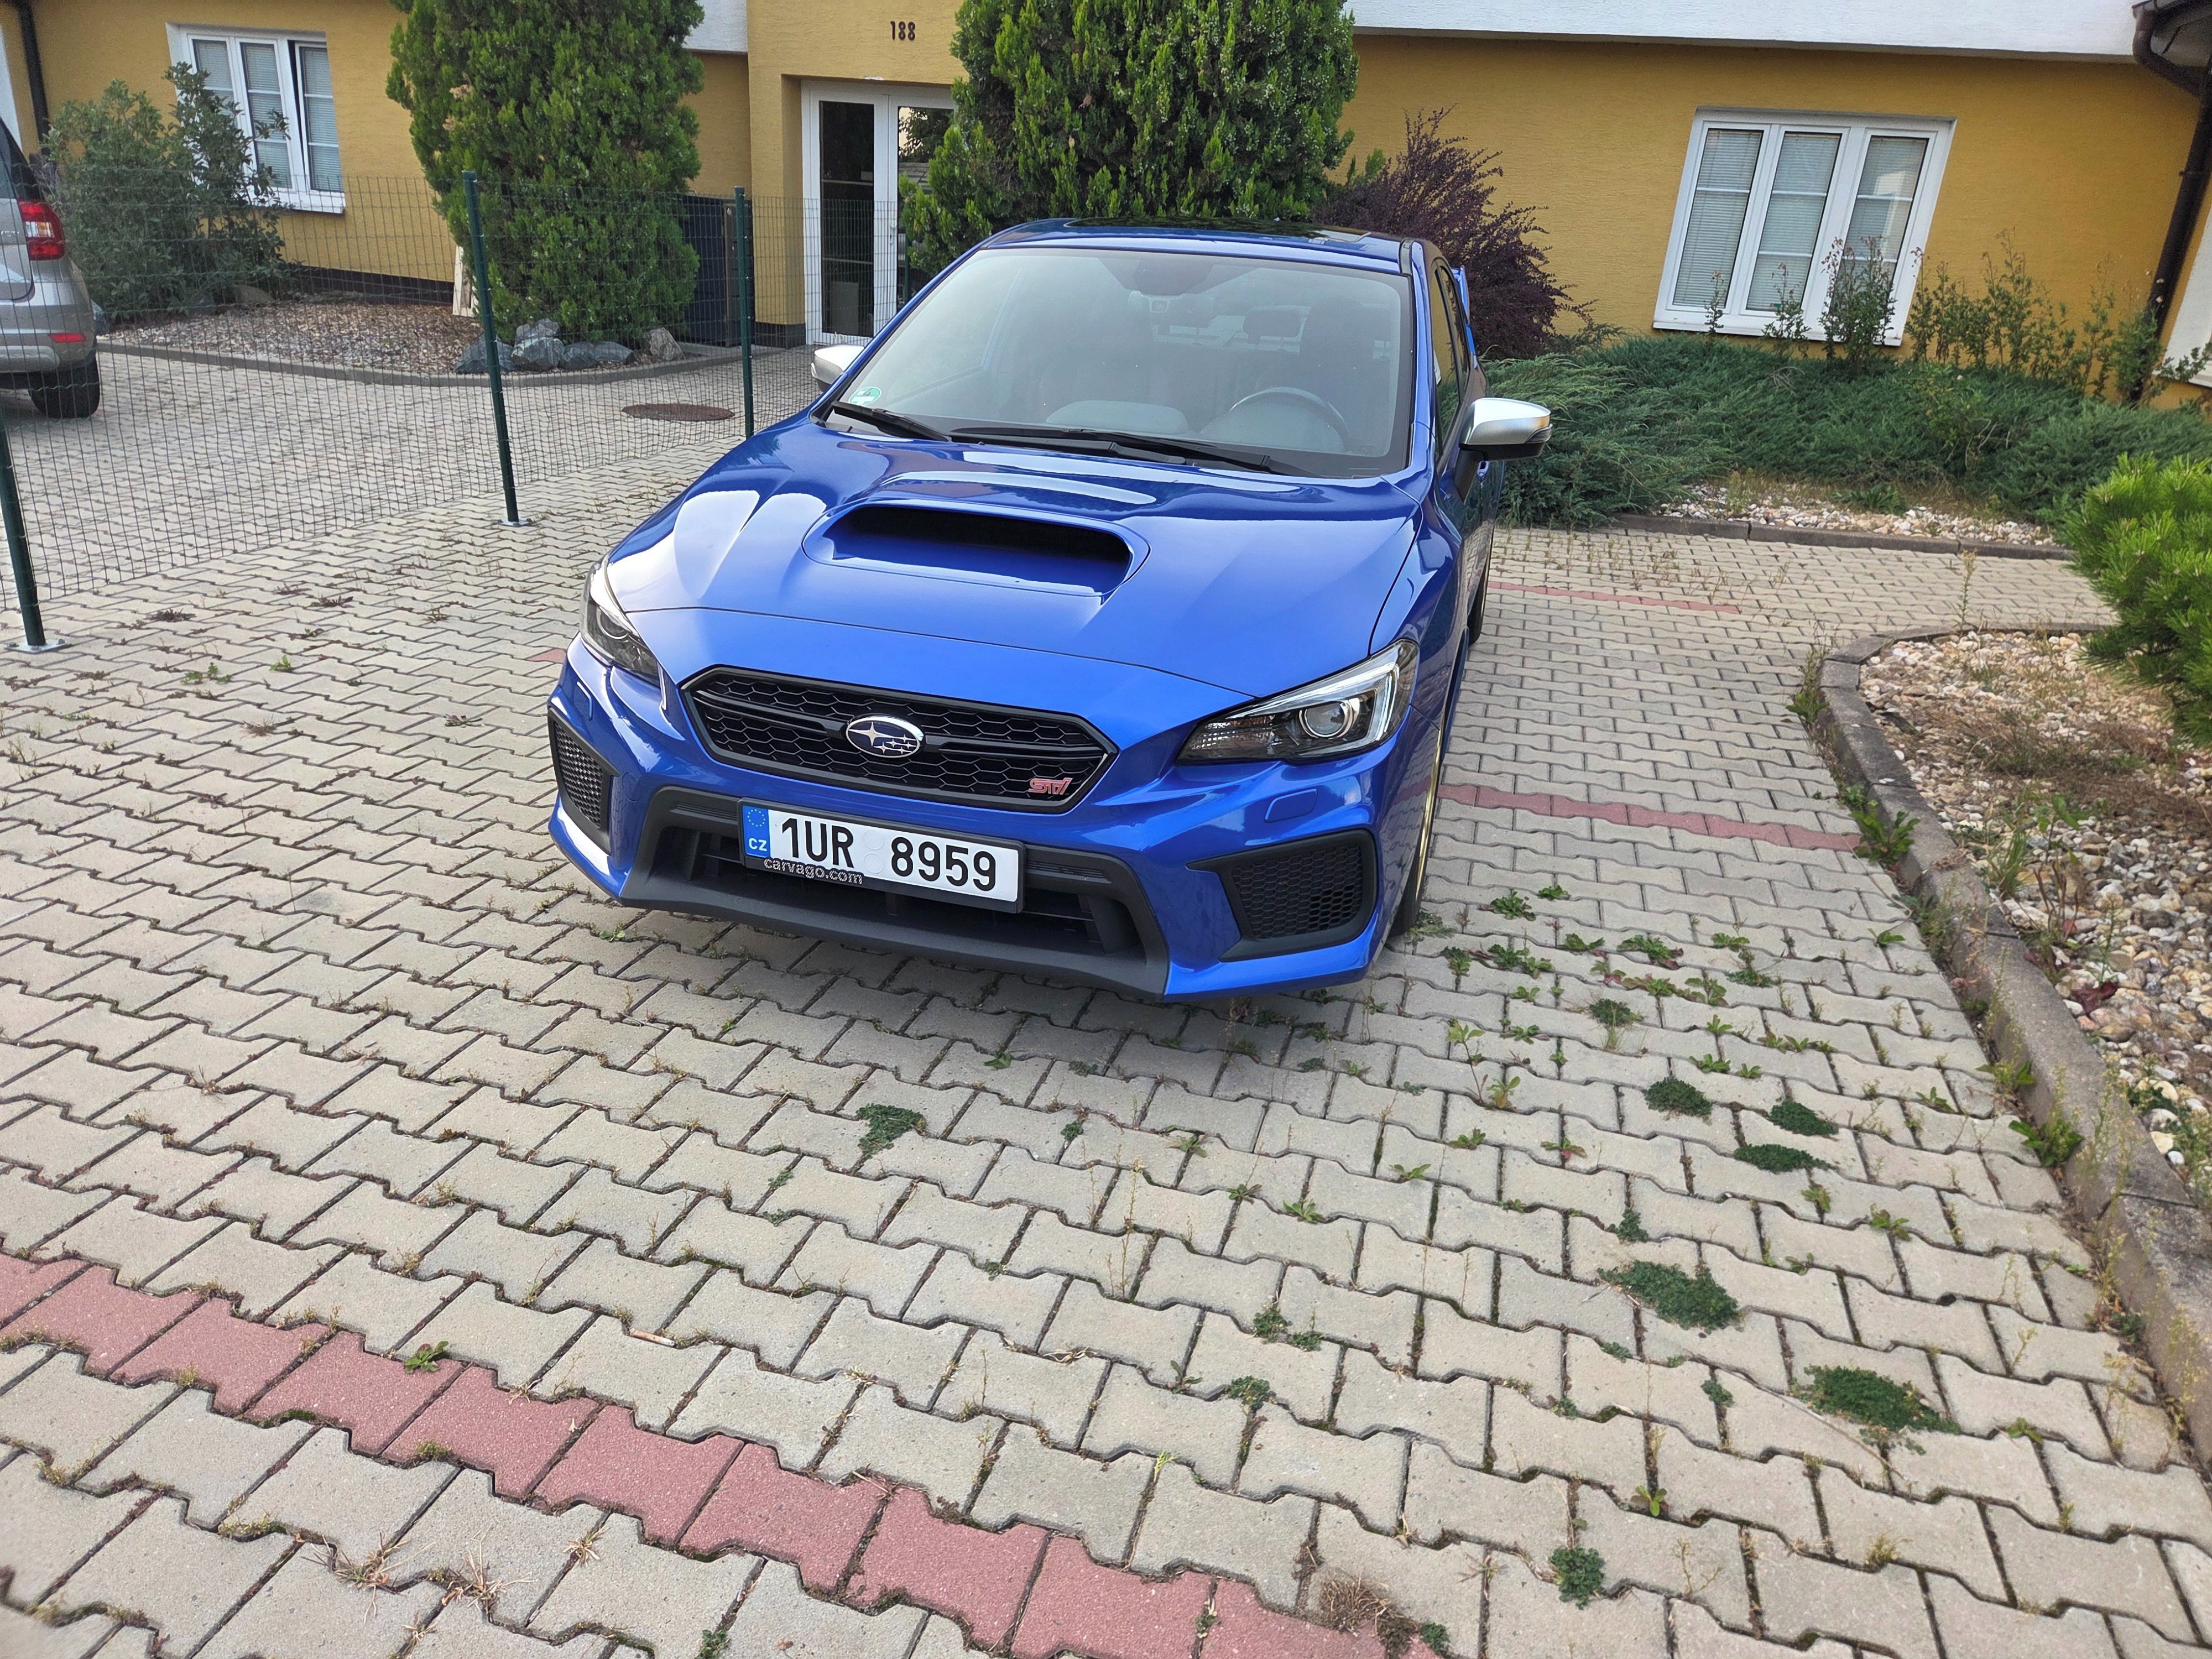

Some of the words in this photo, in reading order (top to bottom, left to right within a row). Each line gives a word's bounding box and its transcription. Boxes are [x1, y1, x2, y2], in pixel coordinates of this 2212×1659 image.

[890, 20, 916, 41] 188
[749, 838, 768, 852] CZ
[782, 818, 854, 868] 1UR
[891, 837, 996, 891] 8959
[764, 858, 863, 885] carvago.com
